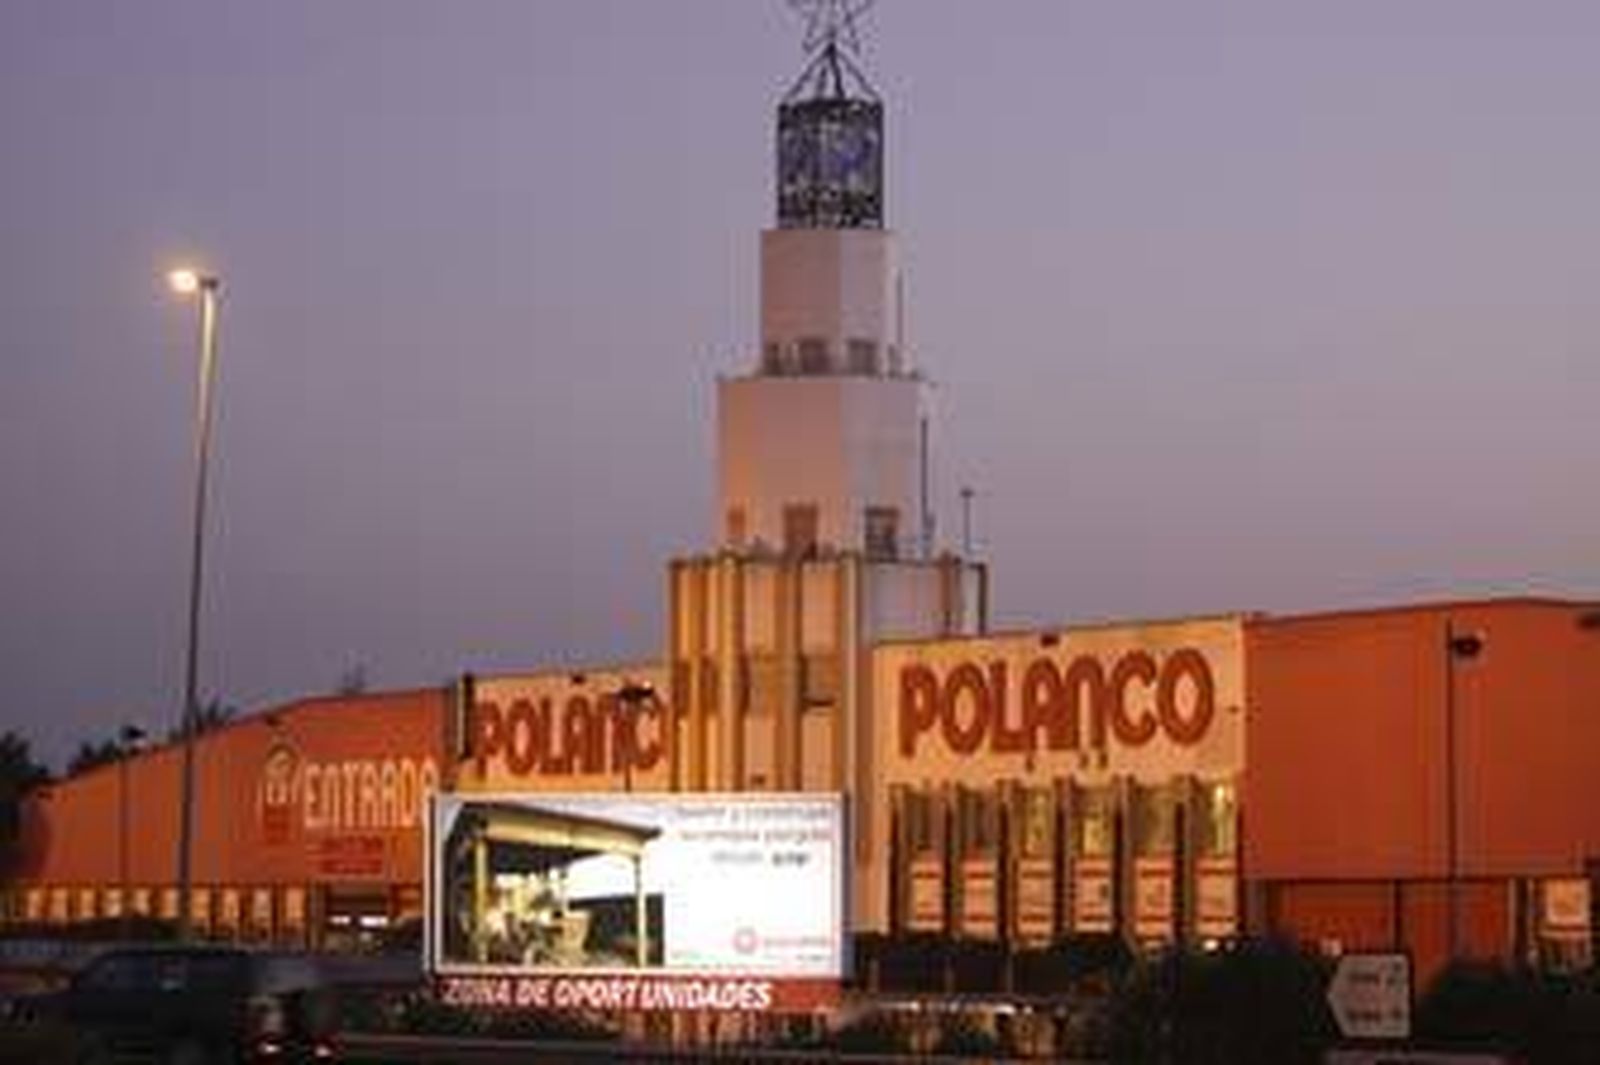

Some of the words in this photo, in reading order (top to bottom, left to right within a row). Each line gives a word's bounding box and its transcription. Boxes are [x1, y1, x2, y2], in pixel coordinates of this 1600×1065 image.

[476, 690, 671, 780] POLANC
[898, 648, 1215, 758] POLANCO
[442, 977, 511, 1005] ZONA
[516, 978, 550, 1006] DE
[554, 979, 773, 1009] OPORTUNIDADES
